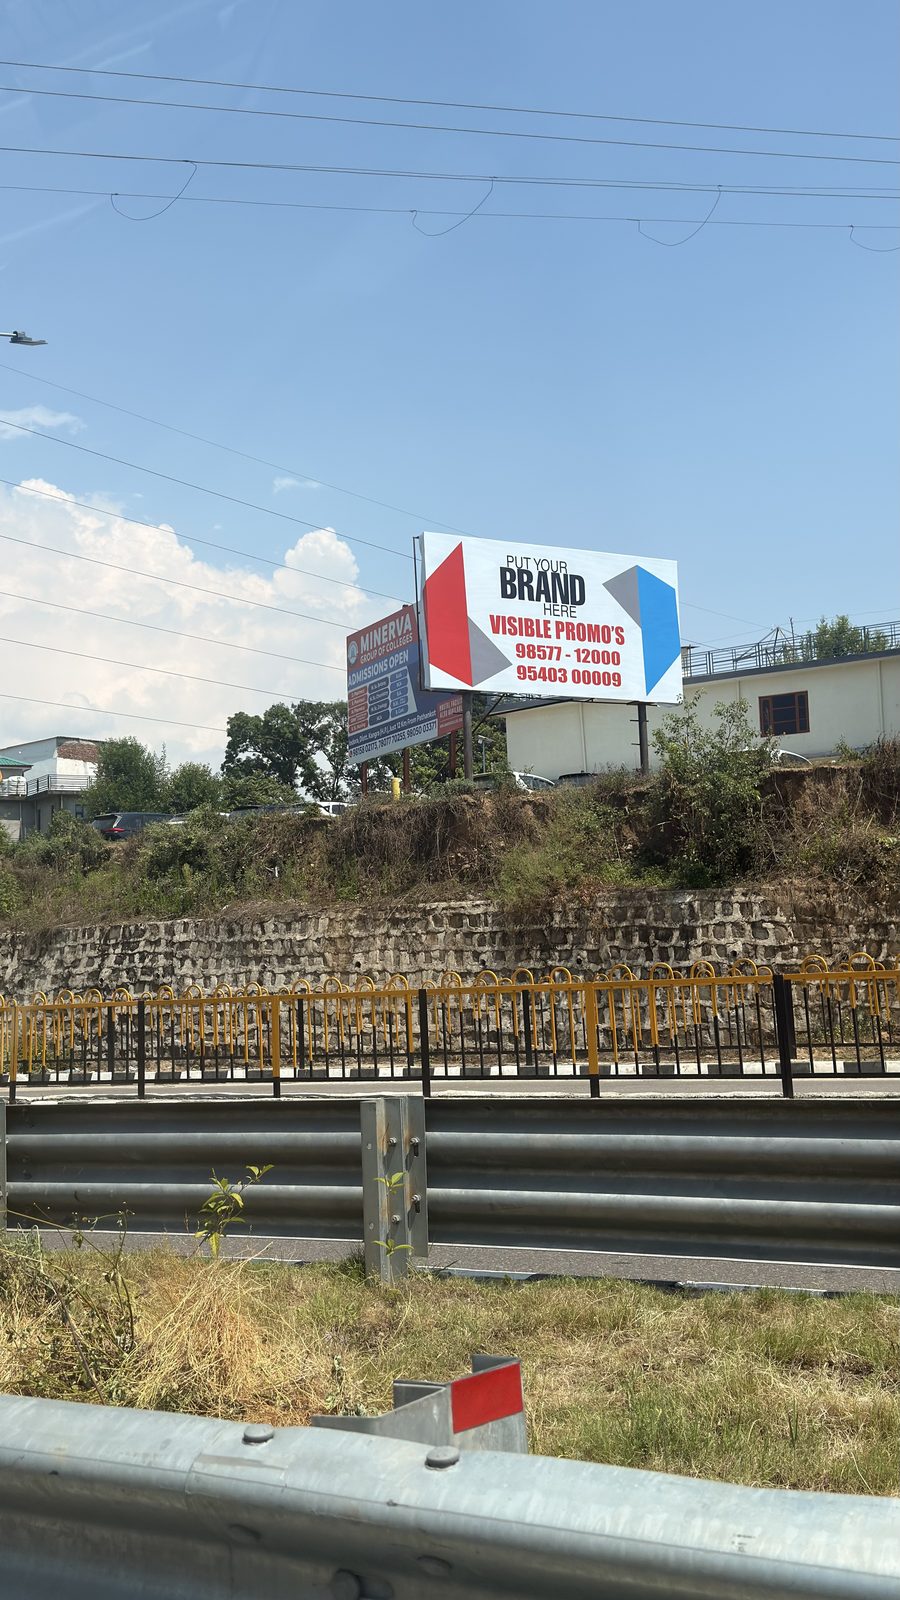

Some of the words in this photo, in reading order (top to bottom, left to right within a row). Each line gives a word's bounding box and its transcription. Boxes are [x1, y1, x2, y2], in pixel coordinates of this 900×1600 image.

[507, 555, 531, 569] PUT
[534, 558, 568, 573] YOUR
[500, 567, 586, 606] BRAND
[544, 603, 577, 618] HERE
[360, 613, 412, 654] MINERVA
[489, 615, 551, 638] VISIBLE
[555, 621, 625, 645] PROMO'S
[360, 649, 377, 664] GROUP
[378, 645, 385, 656] OF
[386, 633, 412, 652] COLLEGES
[516, 643, 561, 661] 98577
[574, 648, 620, 666] 12000
[349, 658, 388, 685] ADMISSIONS
[389, 650, 408, 668] OPEN
[517, 665, 568, 683] 95403
[572, 669, 622, 687] 00009
